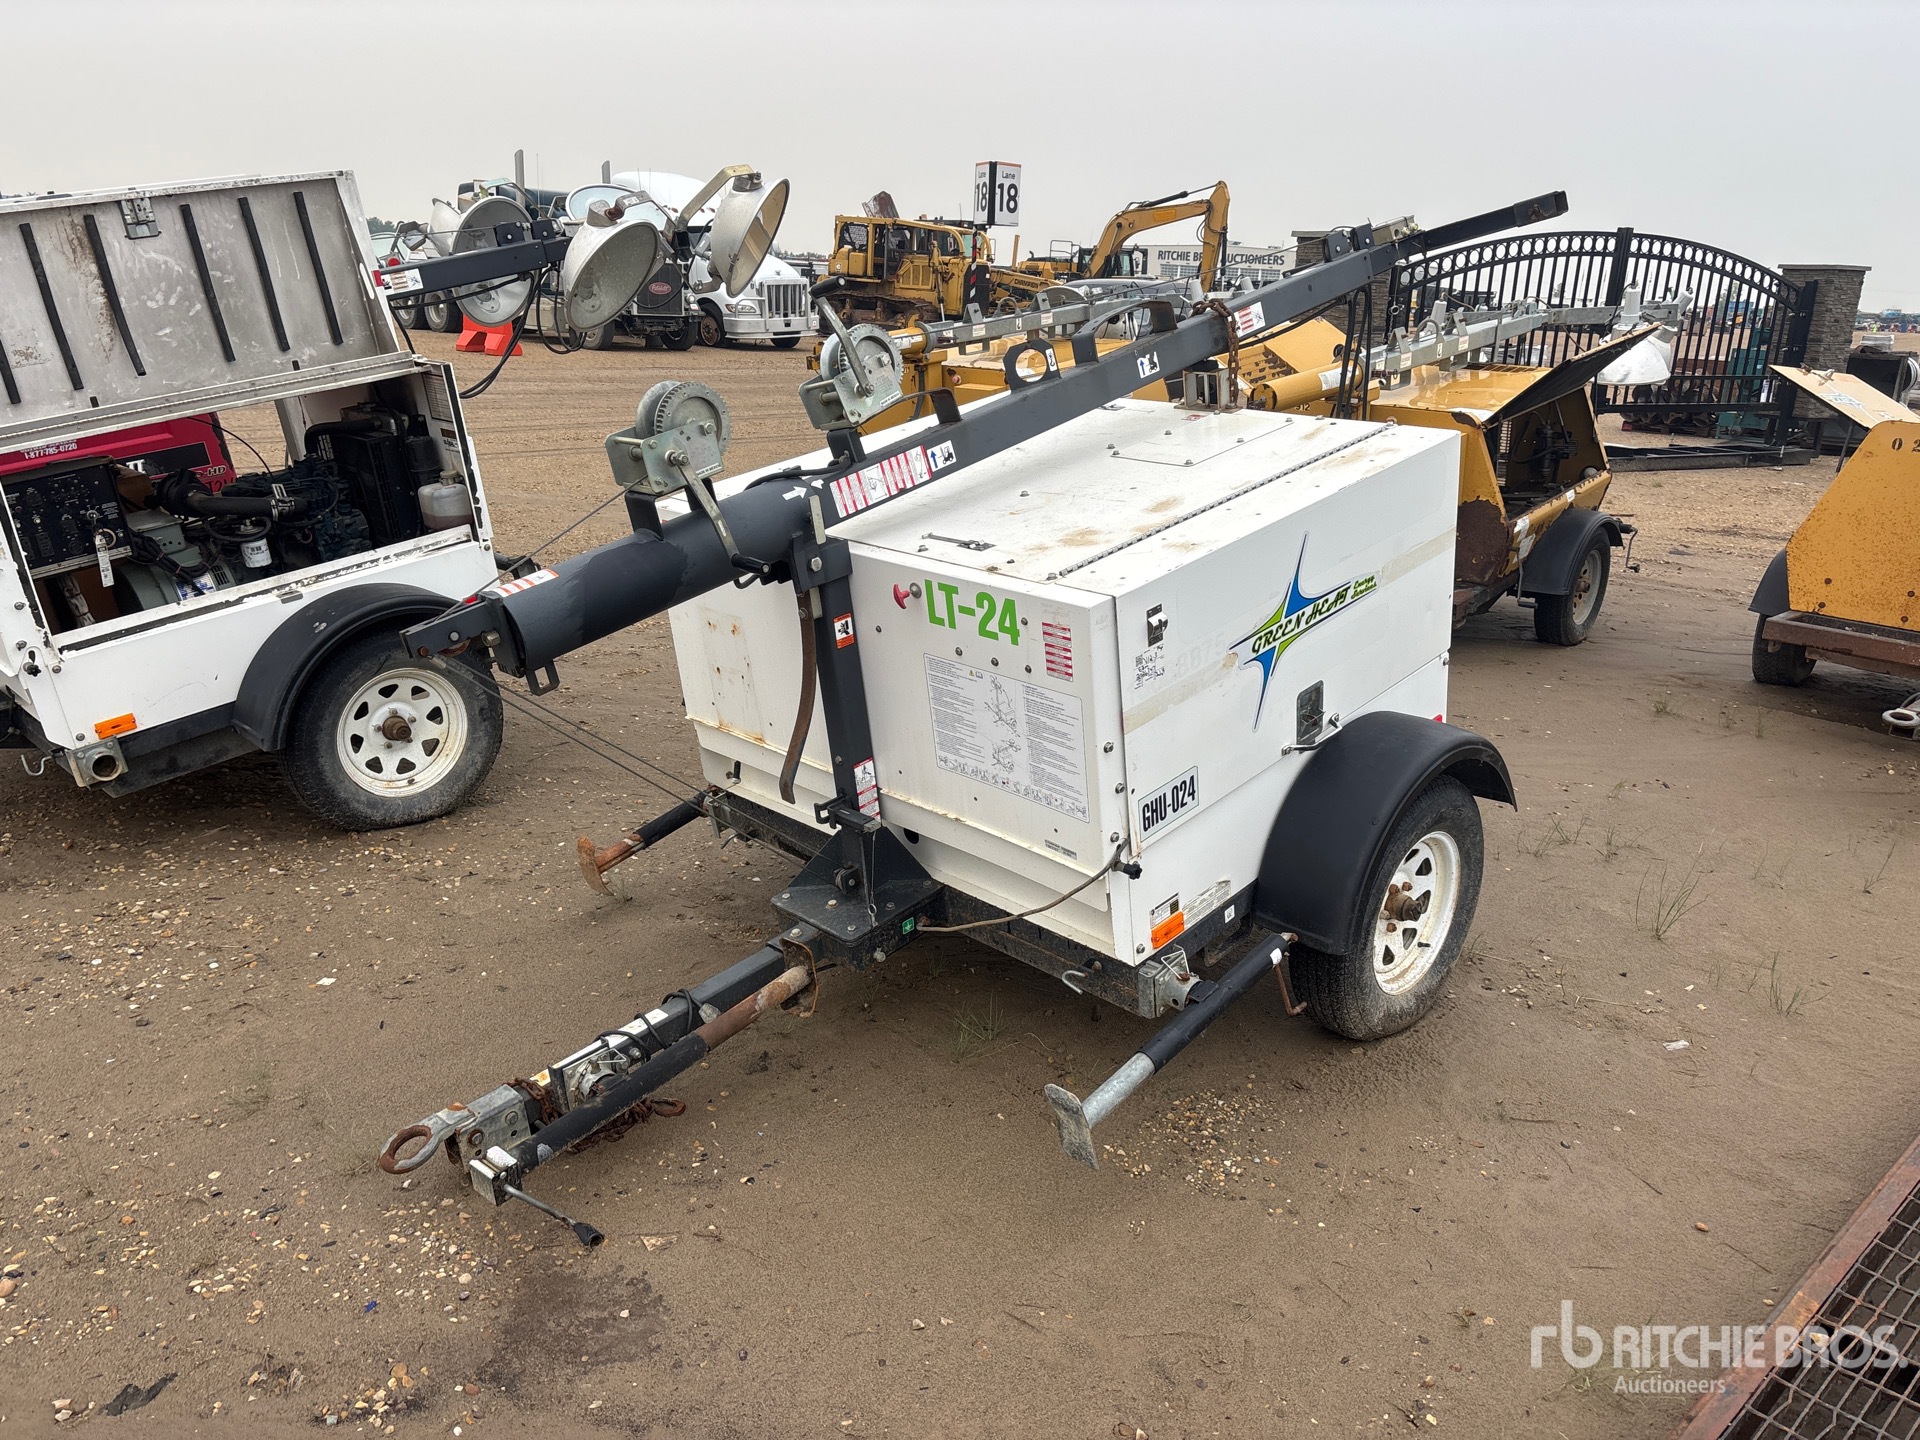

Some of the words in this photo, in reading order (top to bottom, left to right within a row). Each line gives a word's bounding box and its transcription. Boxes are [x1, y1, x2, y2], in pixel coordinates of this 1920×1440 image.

[1001, 170, 1016, 180] Lane
[976, 181, 988, 212] 18
[997, 182, 1019, 214] 18
[1157, 250, 1191, 262] RITCHIE
[1226, 252, 1285, 266] UCTIONEERS
[1353, 574, 1375, 590] Energy
[924, 578, 1021, 647] LT-24
[1251, 610, 1306, 655] GREEN
[1305, 585, 1351, 627] HEAT
[1141, 774, 1197, 833] GHU-024
